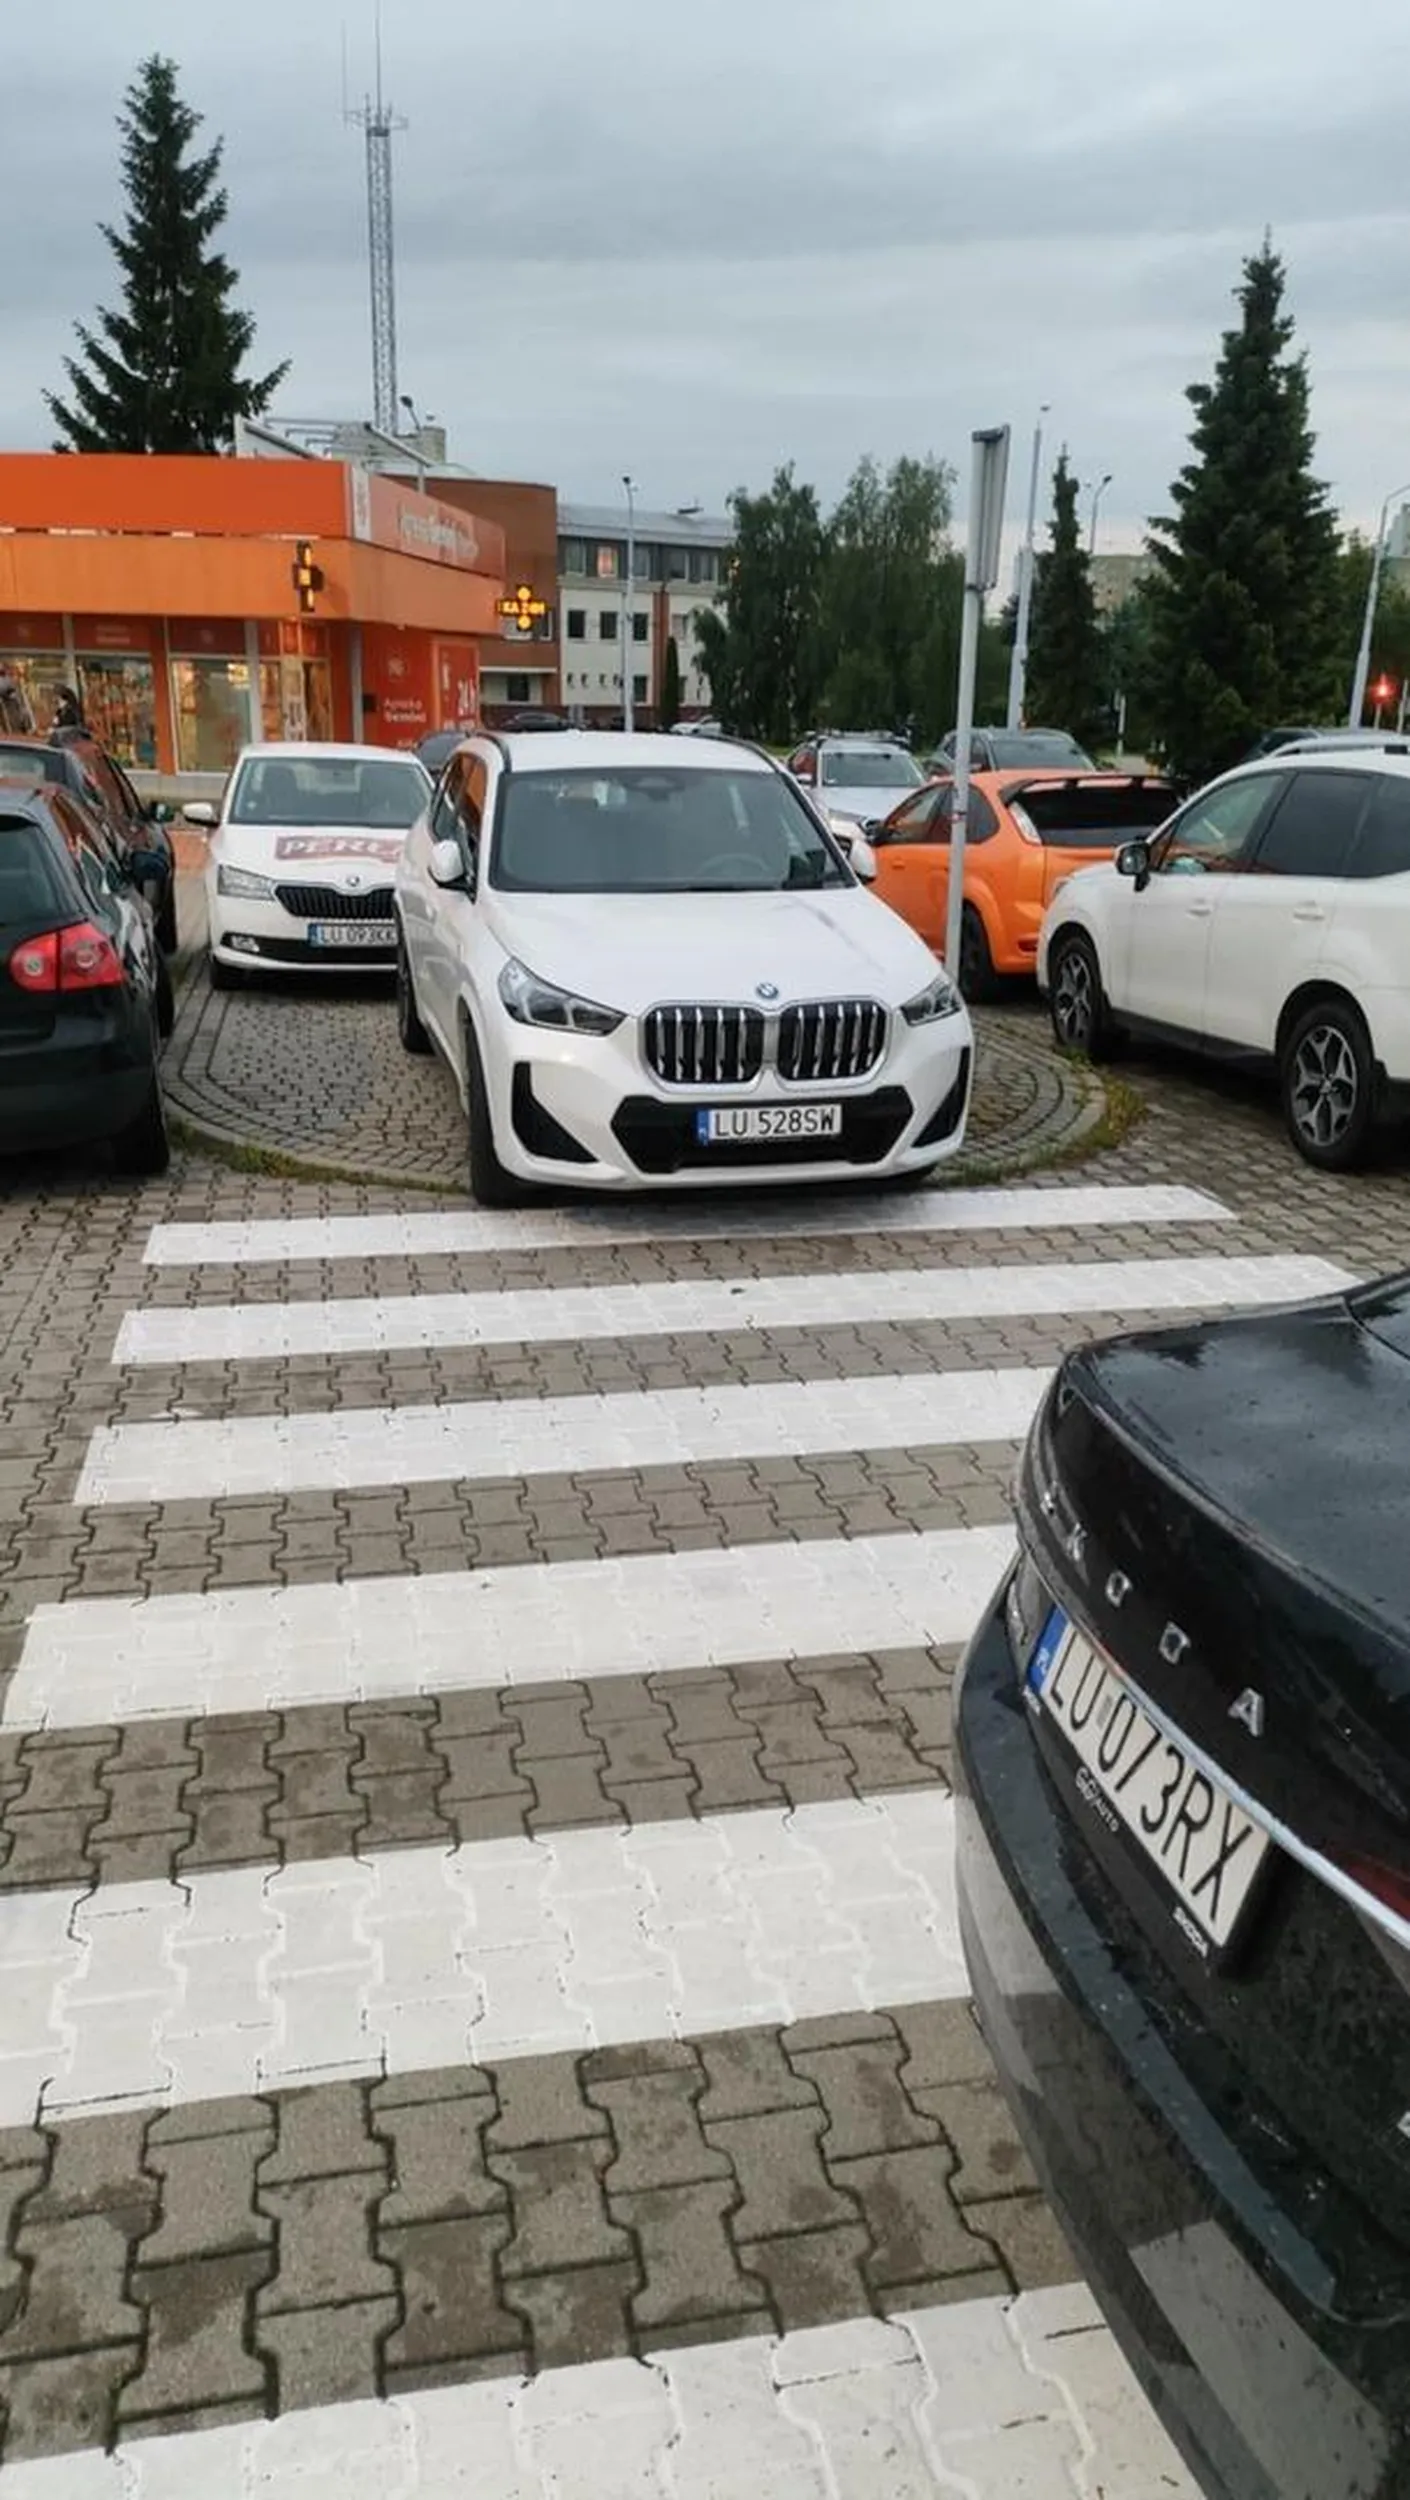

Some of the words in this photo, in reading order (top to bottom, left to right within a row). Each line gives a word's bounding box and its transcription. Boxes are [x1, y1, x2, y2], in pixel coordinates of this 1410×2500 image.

[321, 925, 342, 944] LU
[715, 1112, 748, 1137] LU
[758, 1108, 835, 1135] 528SW
[1051, 1630, 1108, 1730] LU
[1098, 1692, 1254, 1922] 073RX
